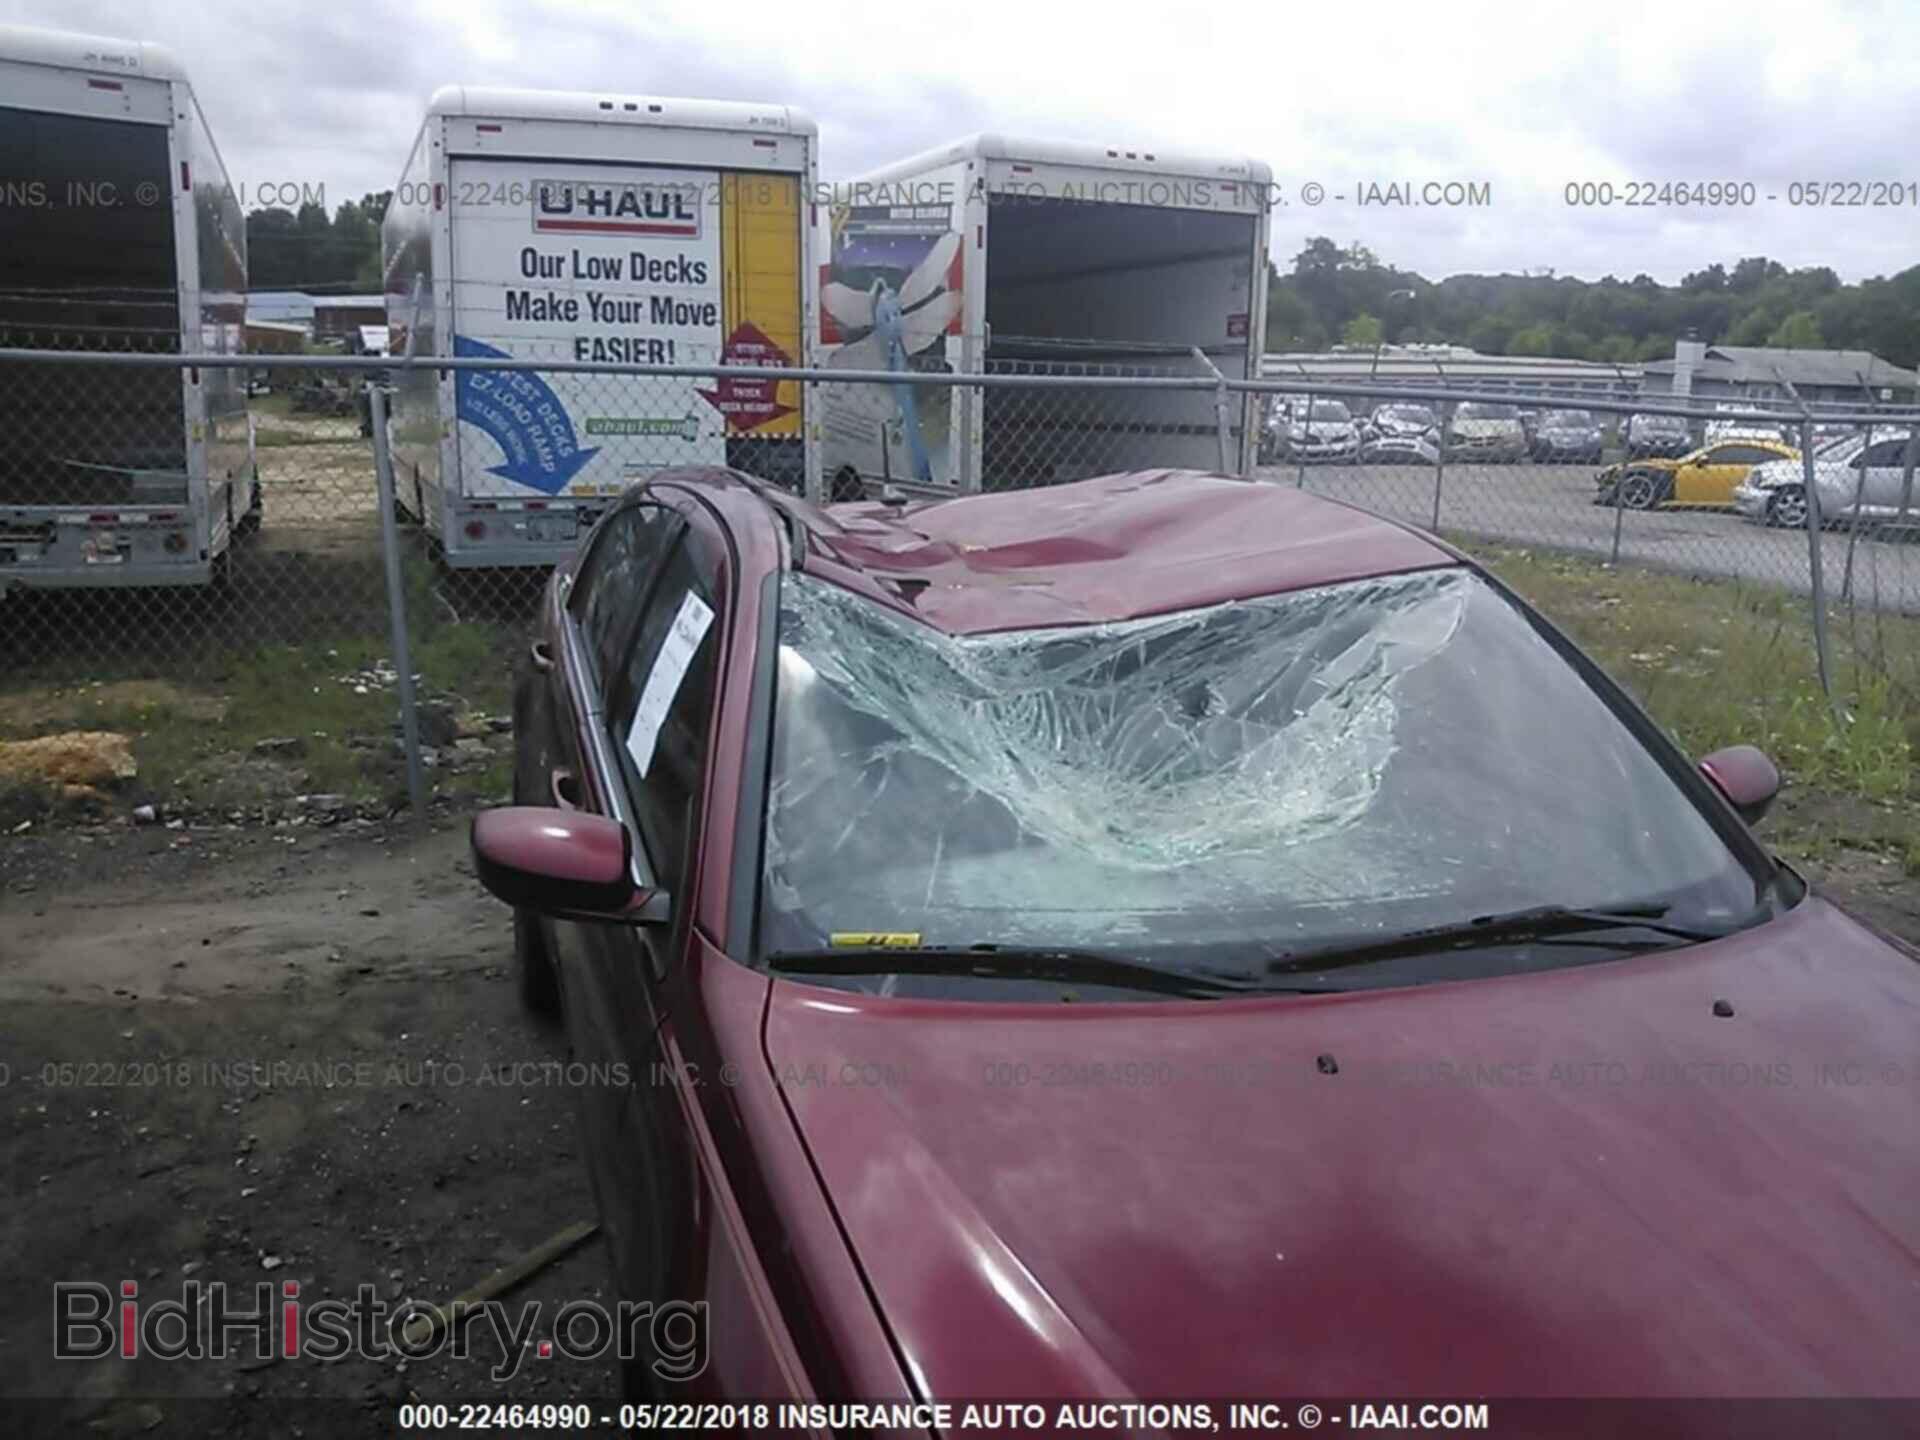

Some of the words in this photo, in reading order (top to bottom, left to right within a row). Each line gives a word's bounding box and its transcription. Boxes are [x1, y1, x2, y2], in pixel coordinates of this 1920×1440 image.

[540, 186, 694, 220] U-HAUL
[521, 247, 566, 279] Our
[572, 249, 623, 281] Low
[629, 251, 708, 285] Decks
[505, 290, 579, 322] Make
[586, 291, 643, 325] Your
[650, 295, 717, 327] Move
[574, 336, 676, 365] EASIER!
[528, 424, 555, 472] RAMP
